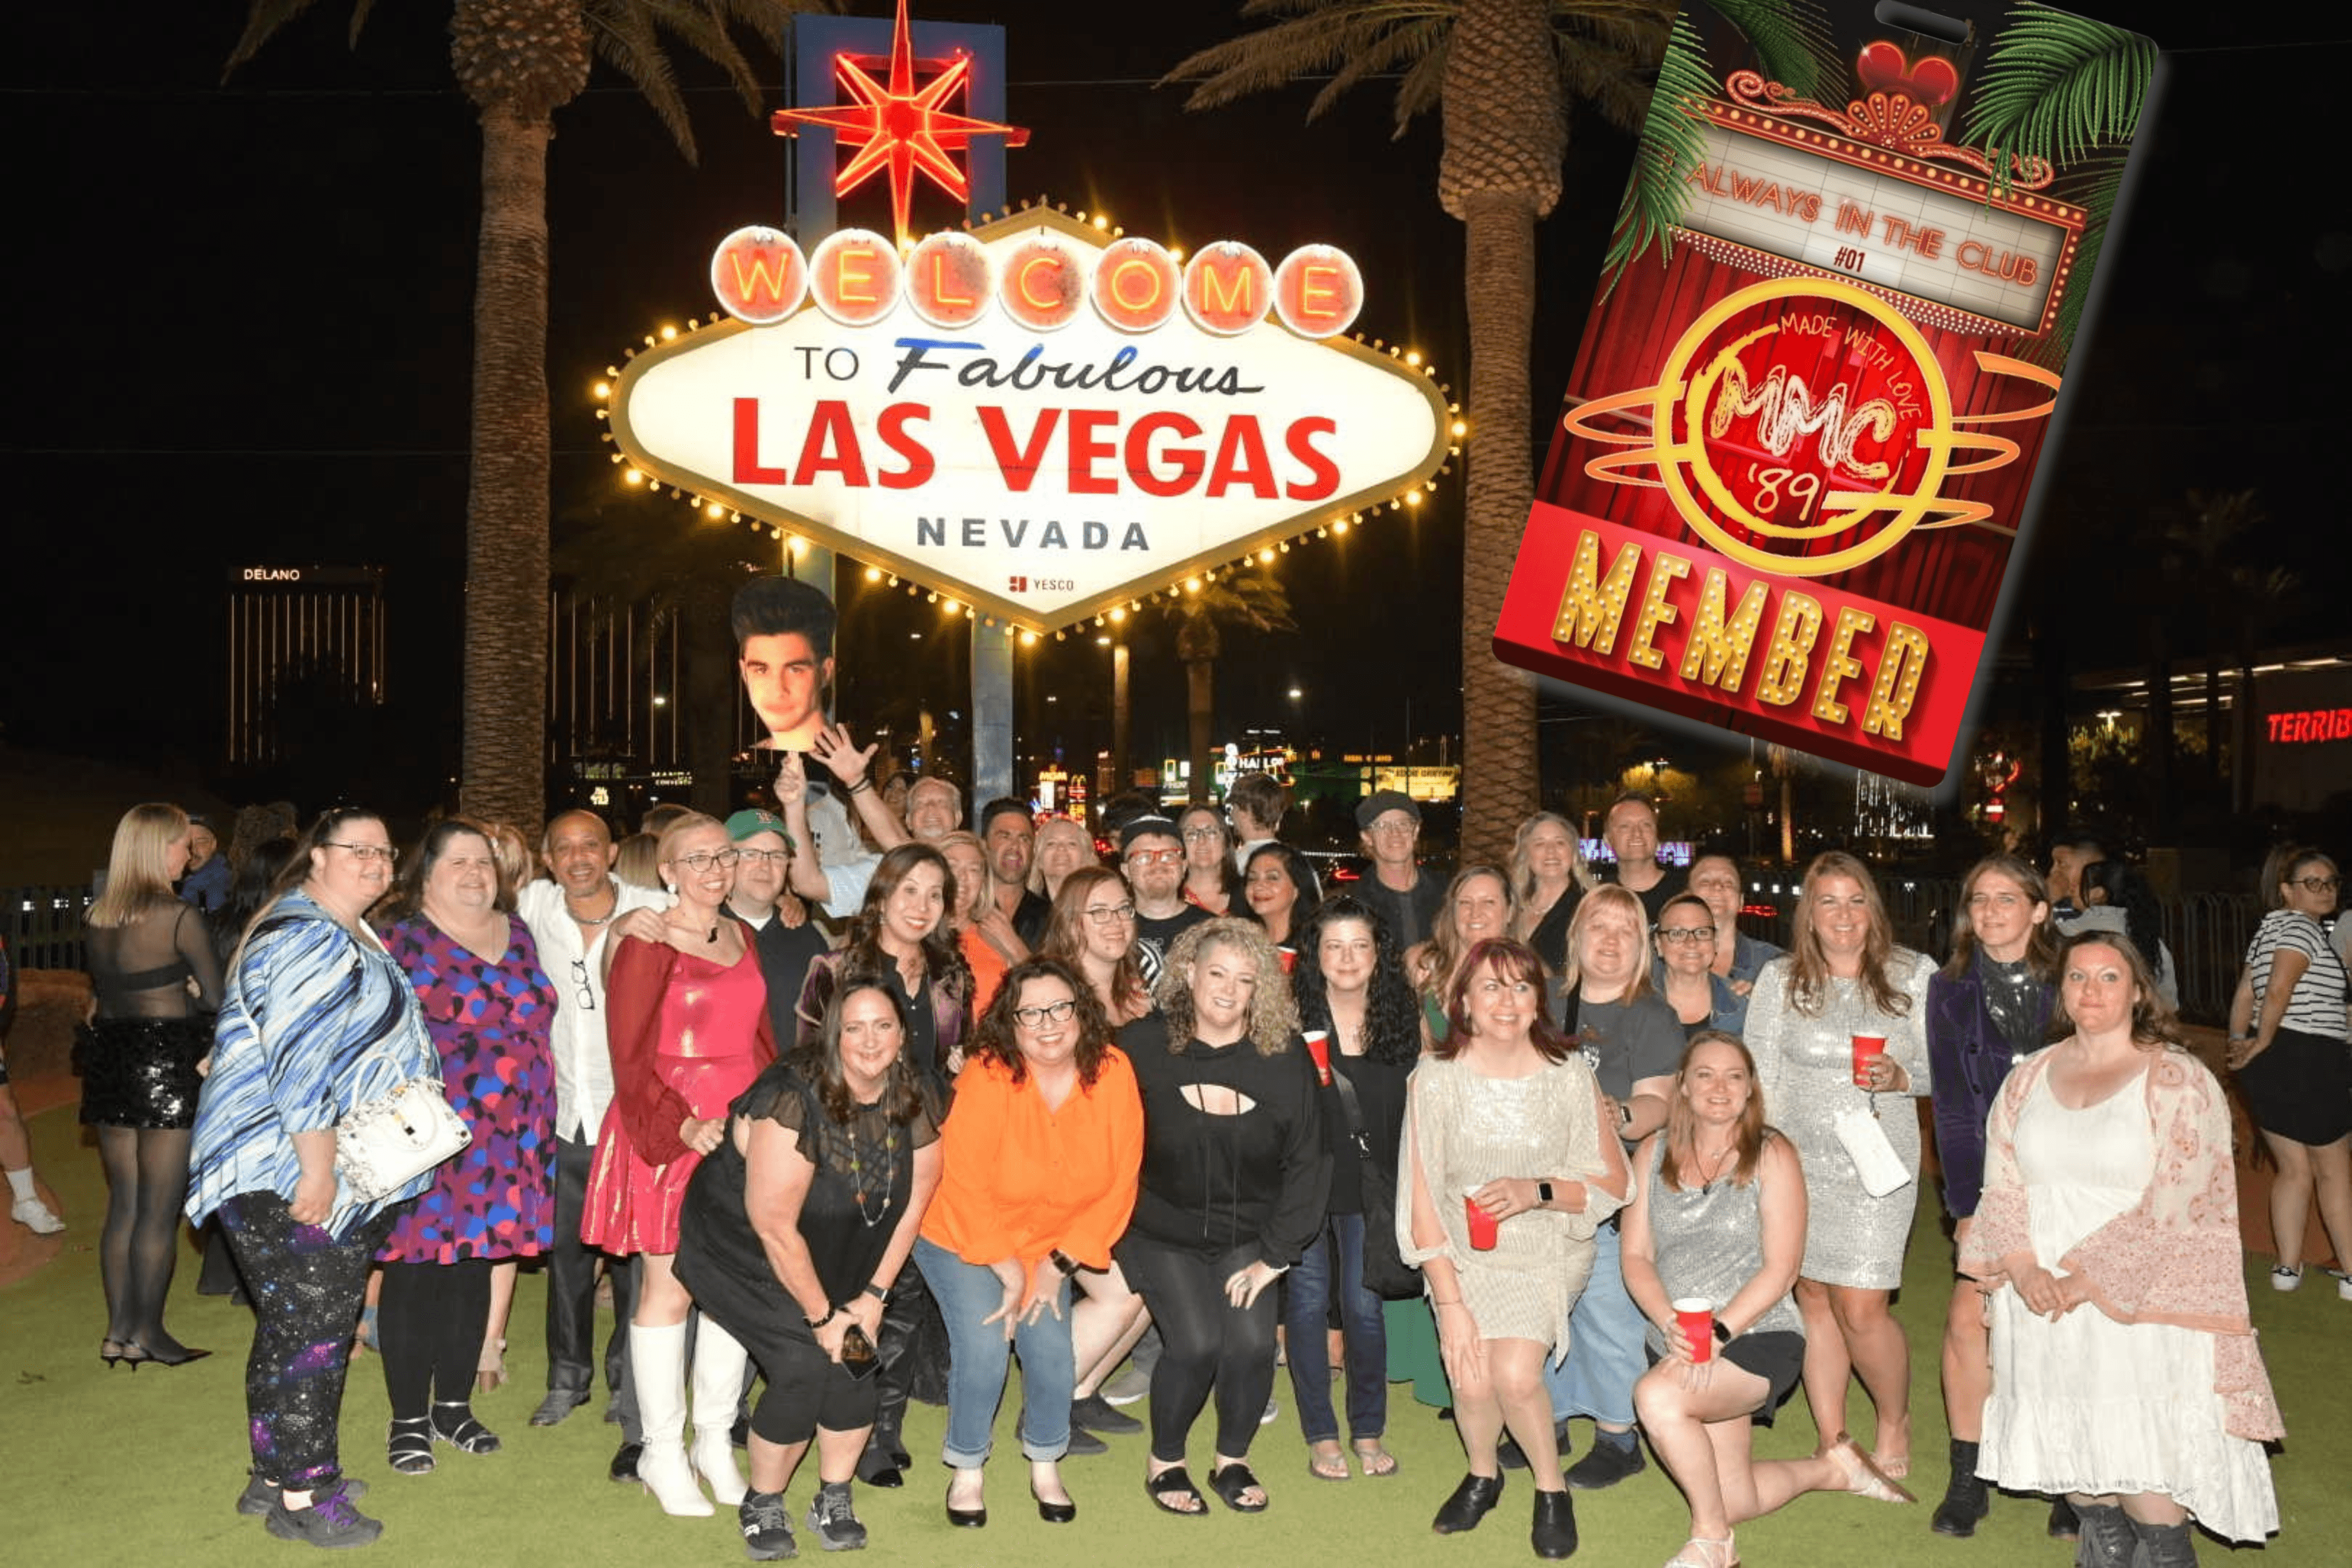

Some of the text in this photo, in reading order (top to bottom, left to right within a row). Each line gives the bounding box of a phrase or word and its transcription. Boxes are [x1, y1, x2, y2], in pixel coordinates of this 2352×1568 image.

[721, 241, 1343, 324] WELCOME
[794, 337, 1266, 396] TO Fabulous
[732, 397, 1341, 501] LAS VEGAS
[916, 517, 1150, 551] NEVADA
[243, 568, 301, 581] DELANO
[1033, 579, 1074, 591] YESCO
